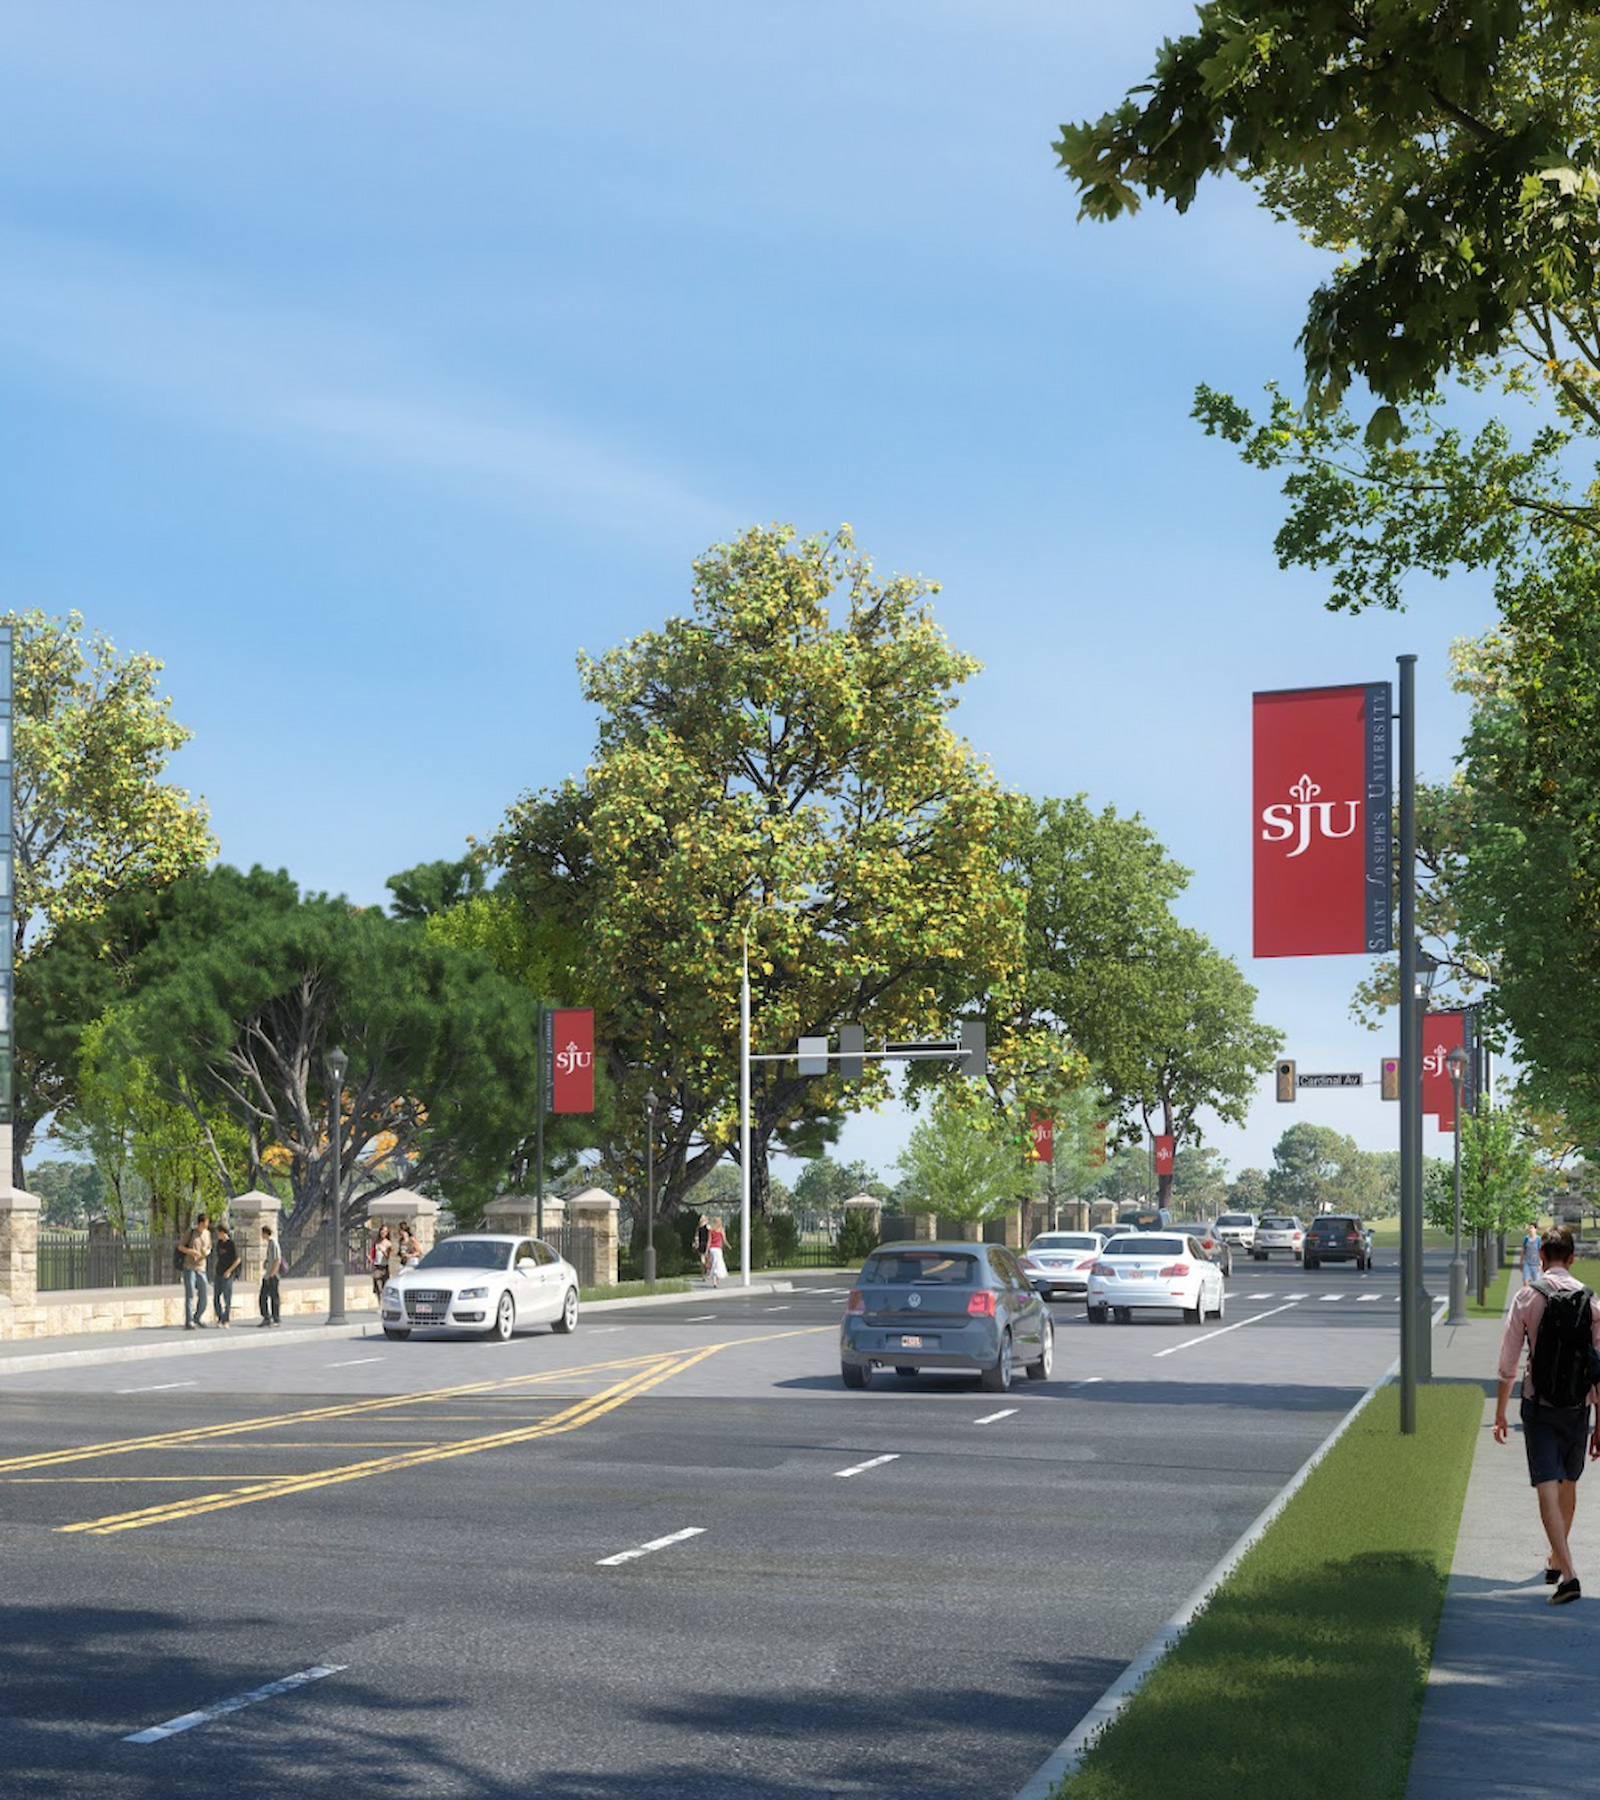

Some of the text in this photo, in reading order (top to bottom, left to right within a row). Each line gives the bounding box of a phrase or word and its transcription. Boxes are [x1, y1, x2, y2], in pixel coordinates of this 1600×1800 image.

[1262, 800, 1361, 858] SJU
[556, 1052, 592, 1075] SJU
[1422, 1055, 1447, 1078] SJ
[1300, 1075, 1341, 1087] Cardinal
